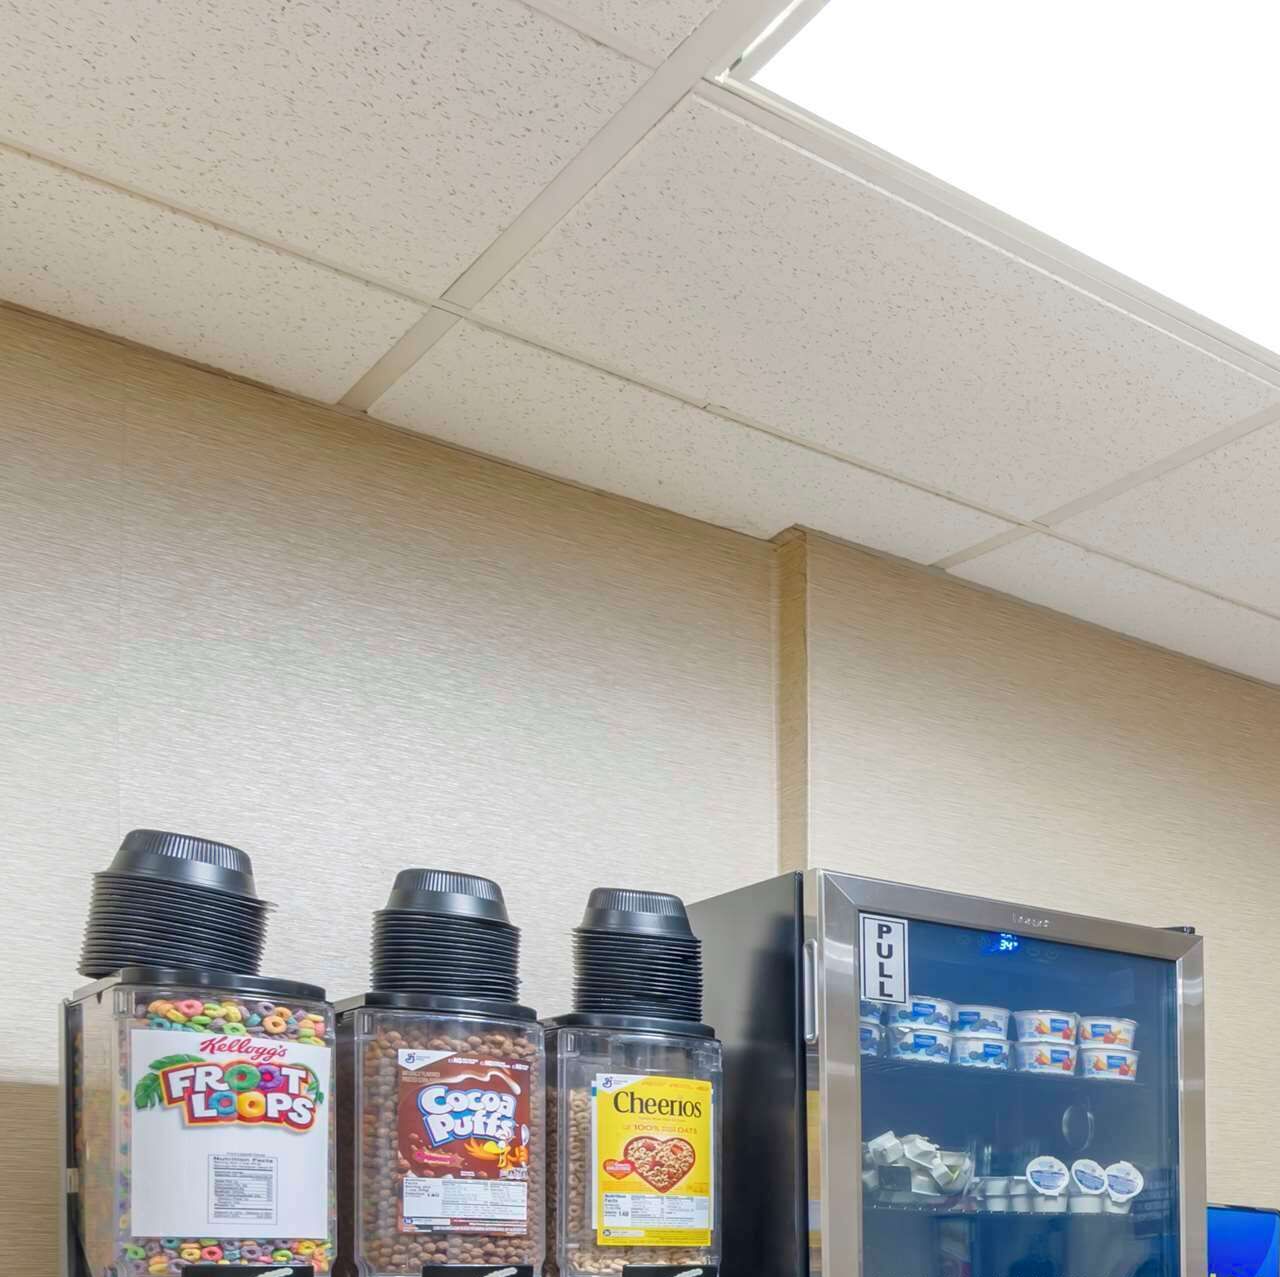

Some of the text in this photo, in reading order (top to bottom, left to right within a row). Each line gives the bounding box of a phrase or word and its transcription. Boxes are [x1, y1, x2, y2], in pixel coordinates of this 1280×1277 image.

[876, 923, 893, 998] PULL
[200, 1036, 288, 1062] Kellogg's
[168, 1064, 307, 1098] FROOT
[191, 1091, 313, 1124] LOOPS
[420, 1087, 516, 1116] Cocoa
[613, 1091, 702, 1118] Cheerios
[428, 1111, 512, 1142] Puffs
